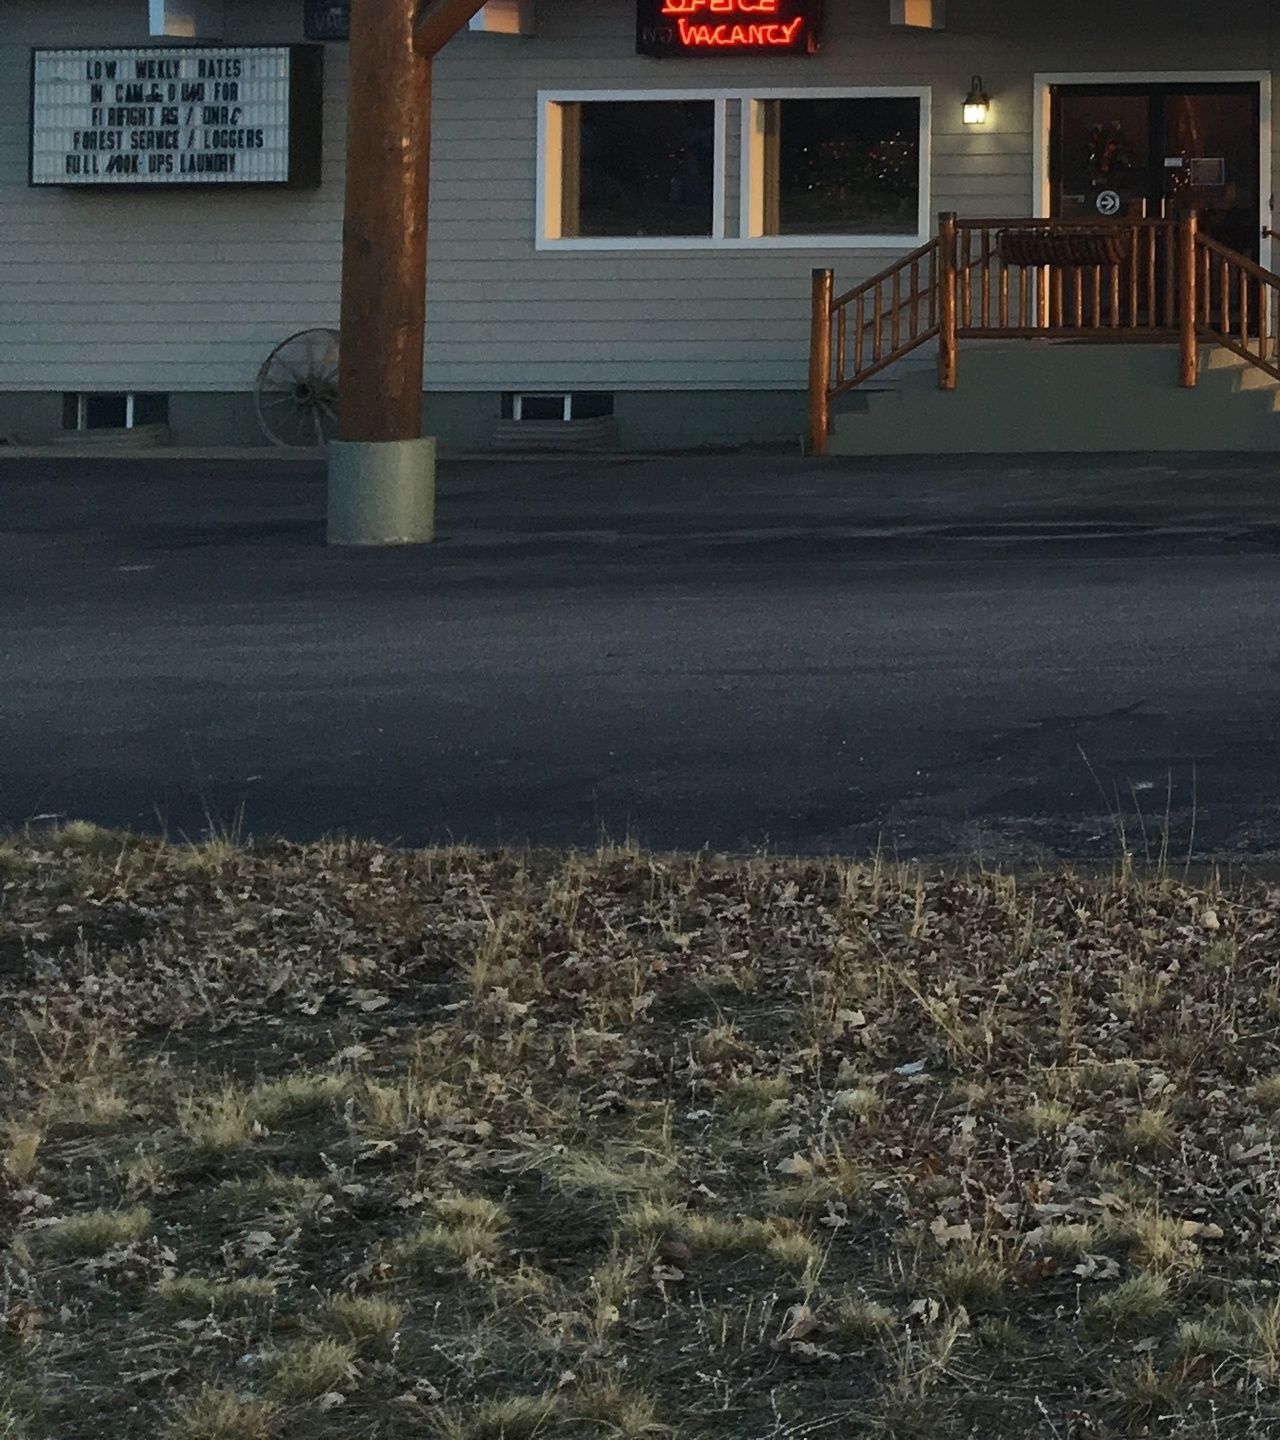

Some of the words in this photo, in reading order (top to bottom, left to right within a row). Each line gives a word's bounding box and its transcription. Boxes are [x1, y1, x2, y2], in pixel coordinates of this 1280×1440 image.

[677, 16, 802, 45] VACANCY
[86, 60, 117, 79] LOW
[198, 59, 242, 79] RATES
[214, 82, 239, 102] FOR
[73, 131, 124, 151] FOREST
[204, 129, 264, 149] LOGGERS
[66, 155, 100, 175] FULL
[180, 154, 236, 174] LAUNDRY
